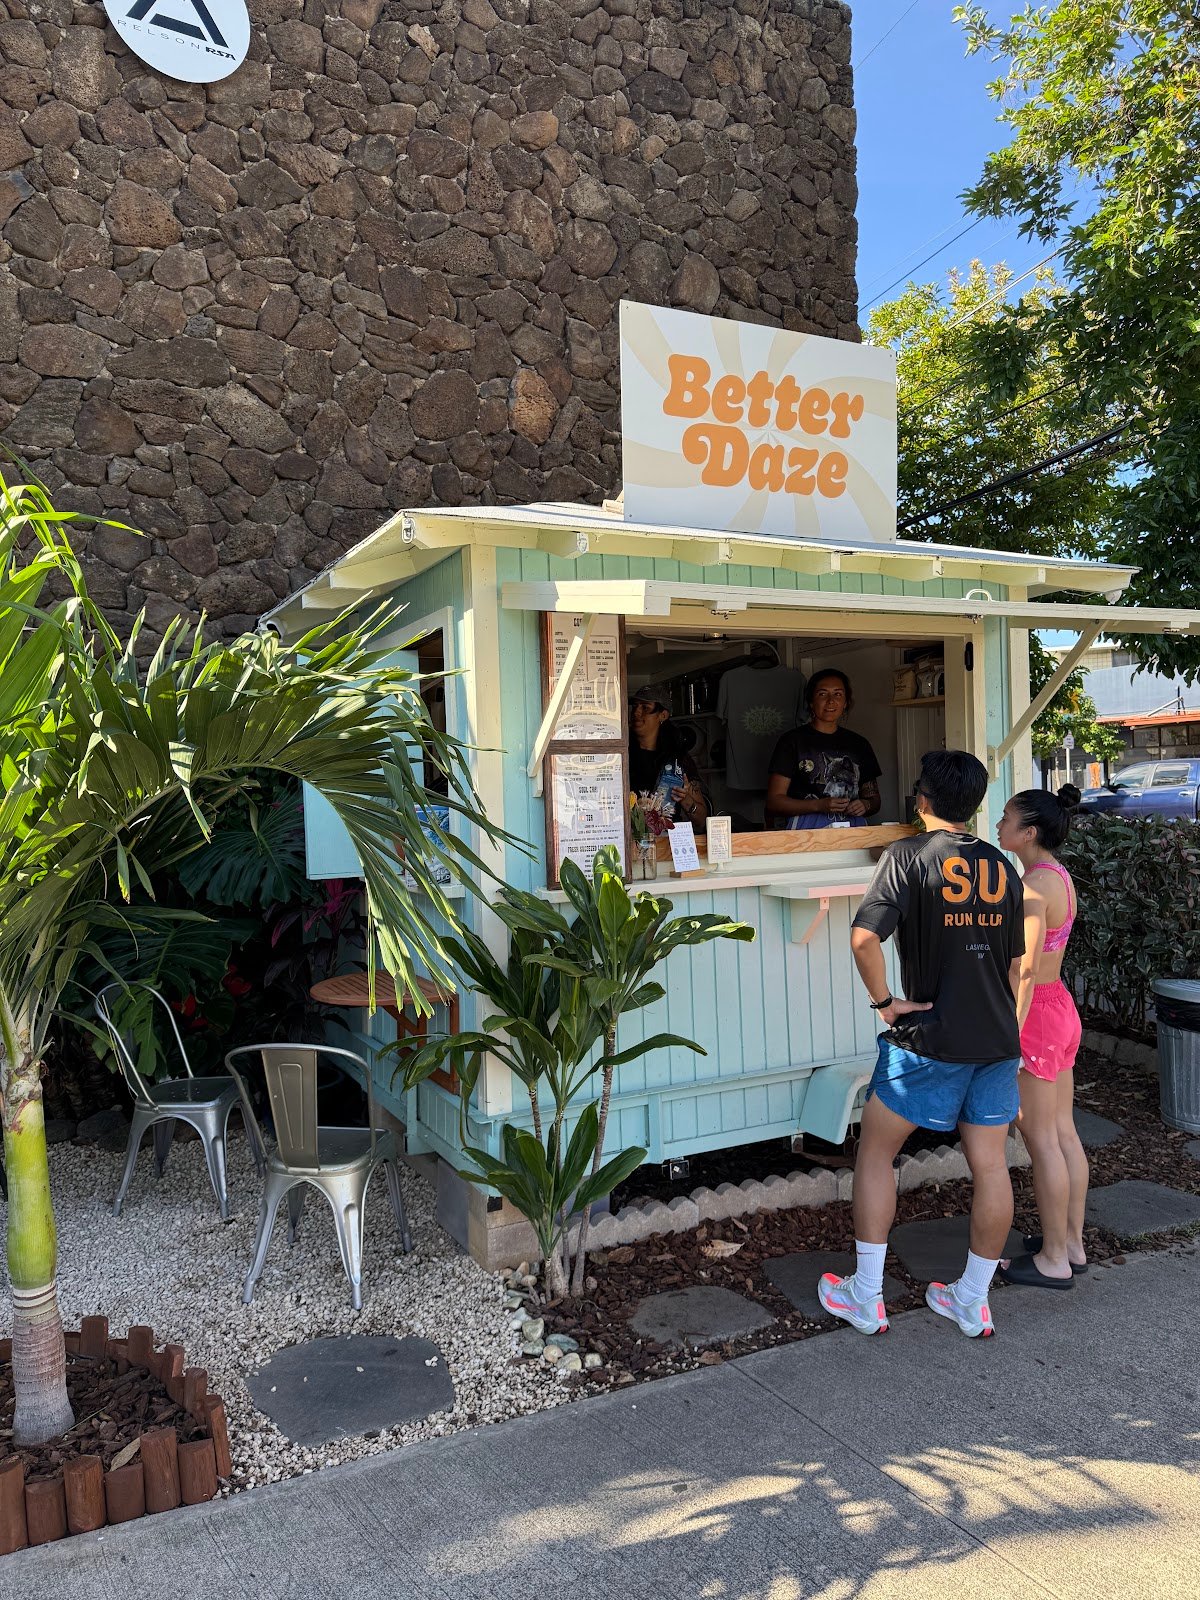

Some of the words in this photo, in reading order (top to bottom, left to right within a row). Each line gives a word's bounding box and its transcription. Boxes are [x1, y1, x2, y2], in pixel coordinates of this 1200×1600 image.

[117, 19, 200, 50] RELSON
[662, 353, 865, 439] Better
[681, 422, 849, 499] Daze
[944, 912, 973, 927] RUN
